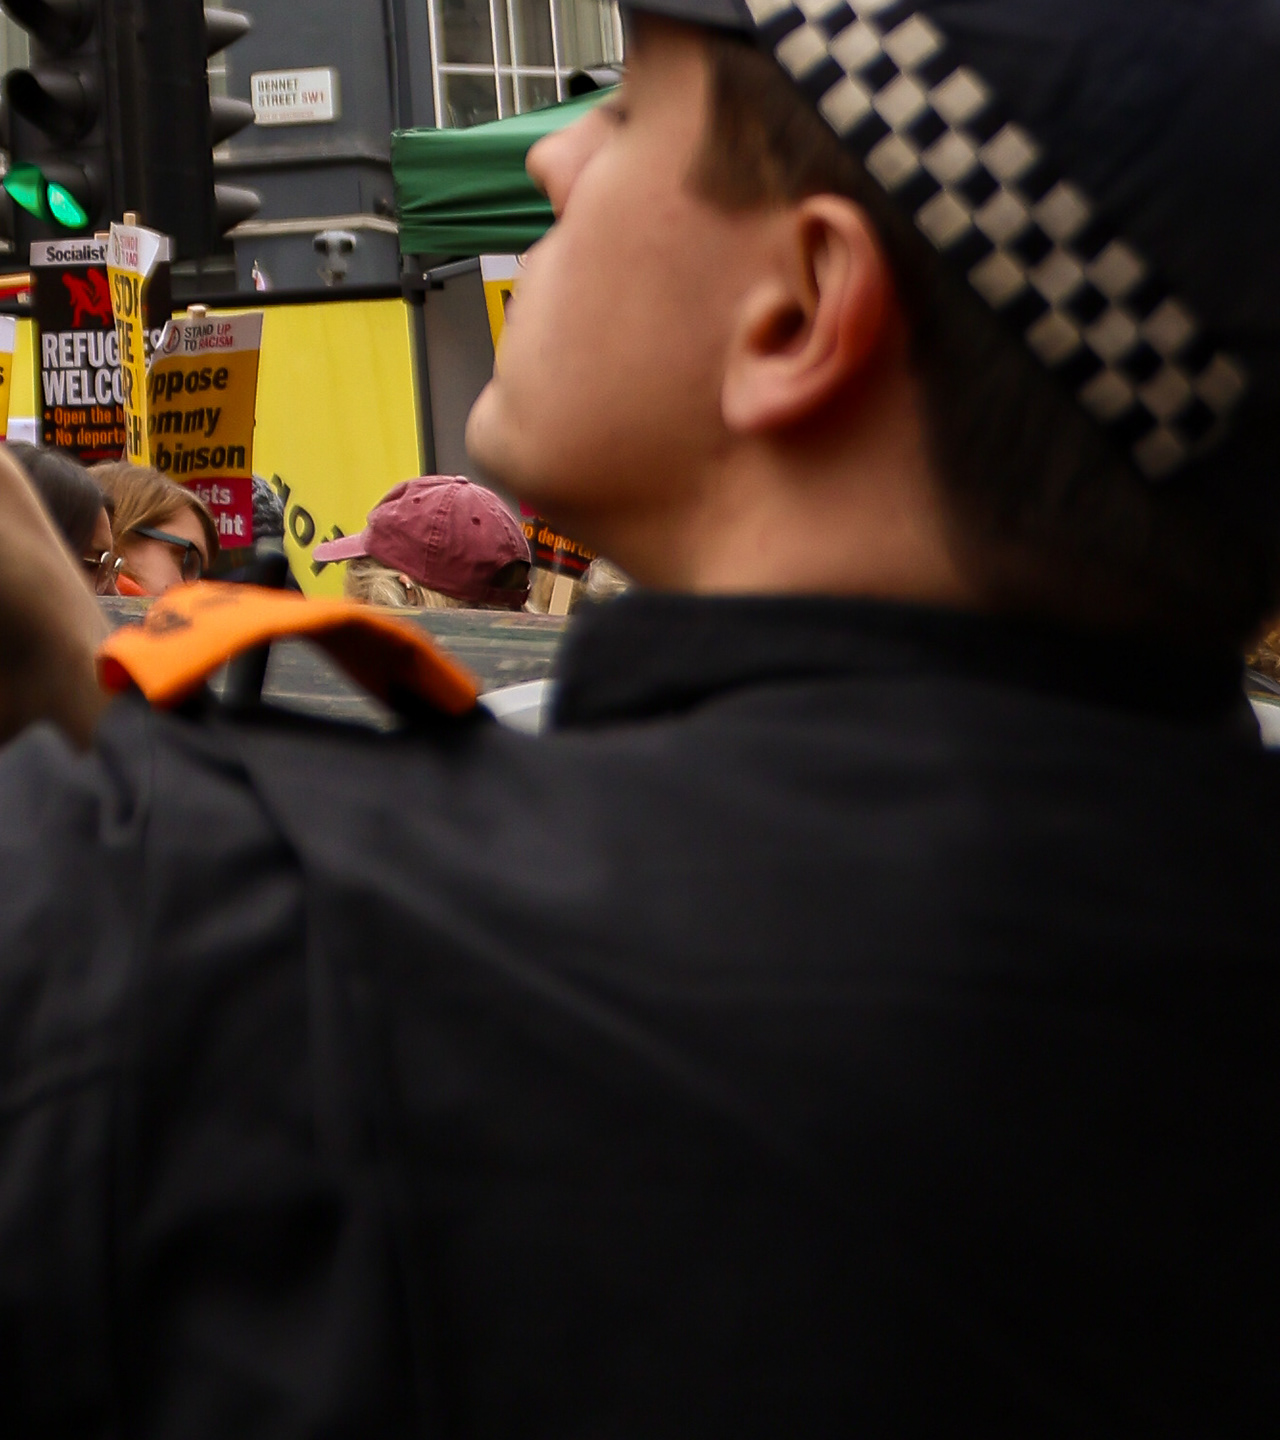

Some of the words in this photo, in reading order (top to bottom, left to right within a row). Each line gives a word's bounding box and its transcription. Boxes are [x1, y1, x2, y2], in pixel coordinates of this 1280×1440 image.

[258, 93, 297, 107] STREET
[301, 91, 324, 104] SW1
[46, 245, 105, 262] Socialist
[185, 324, 214, 337] STAND
[217, 323, 231, 335] UP
[184, 339, 197, 351] TO
[199, 335, 233, 349] RACISM
[42, 368, 124, 406] WELCO
[54, 407, 86, 428] Open
[90, 405, 112, 424] the
[55, 427, 72, 447] No
[77, 427, 127, 448] deporta
[157, 443, 245, 474] binson
